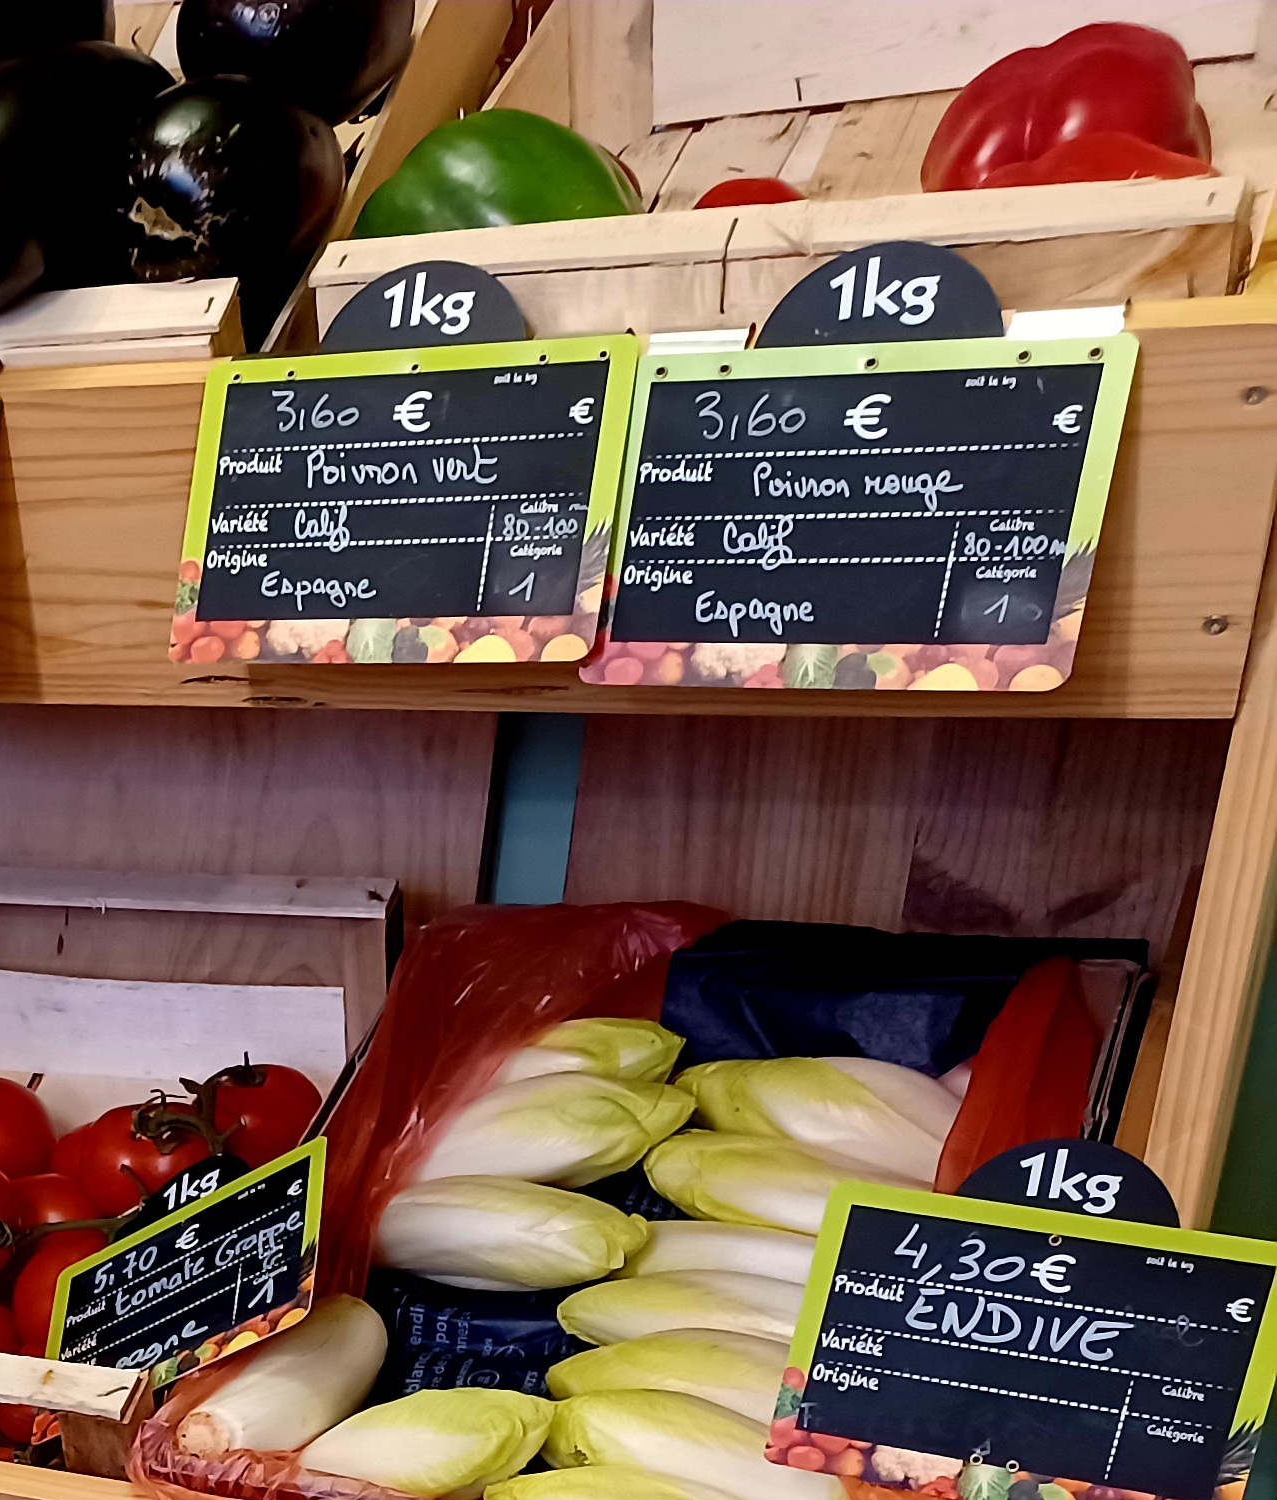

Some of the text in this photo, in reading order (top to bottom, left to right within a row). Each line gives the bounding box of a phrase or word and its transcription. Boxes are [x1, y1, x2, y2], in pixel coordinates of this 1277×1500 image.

[383, 271, 476, 335] 1kg
[830, 256, 942, 326] 1kg
[271, 390, 434, 432] 3,60 €
[694, 390, 892, 440] 3,60 €
[219, 456, 283, 478] Produit
[306, 445, 498, 489] Poivron vert
[640, 461, 713, 485] Produit
[753, 461, 963, 512] Poivron rouge
[212, 512, 268, 534] Variété
[630, 522, 696, 547] Variété
[989, 519, 1035, 533] Calibre
[206, 551, 267, 574] Origine
[510, 544, 563, 558] Catégorie
[508, 572, 536, 601] 1
[623, 565, 693, 591] Origine
[975, 566, 1037, 581] Catégorie
[260, 570, 377, 611] Espagne
[695, 591, 815, 637] Espagne
[983, 594, 1009, 624] 1
[163, 1168, 220, 1210] 1kg
[1019, 1148, 1124, 1215] 1kg
[94, 1224, 200, 1294] 5,70 €
[894, 1223, 1077, 1294] 4,30 €
[834, 1275, 906, 1303] Produit
[904, 1287, 1135, 1362] ENDIVE
[821, 1330, 884, 1358] Variété
[812, 1363, 880, 1392] Origine
[1162, 1384, 1205, 1402] Calibre
[1146, 1424, 1205, 1445] Catégorie
